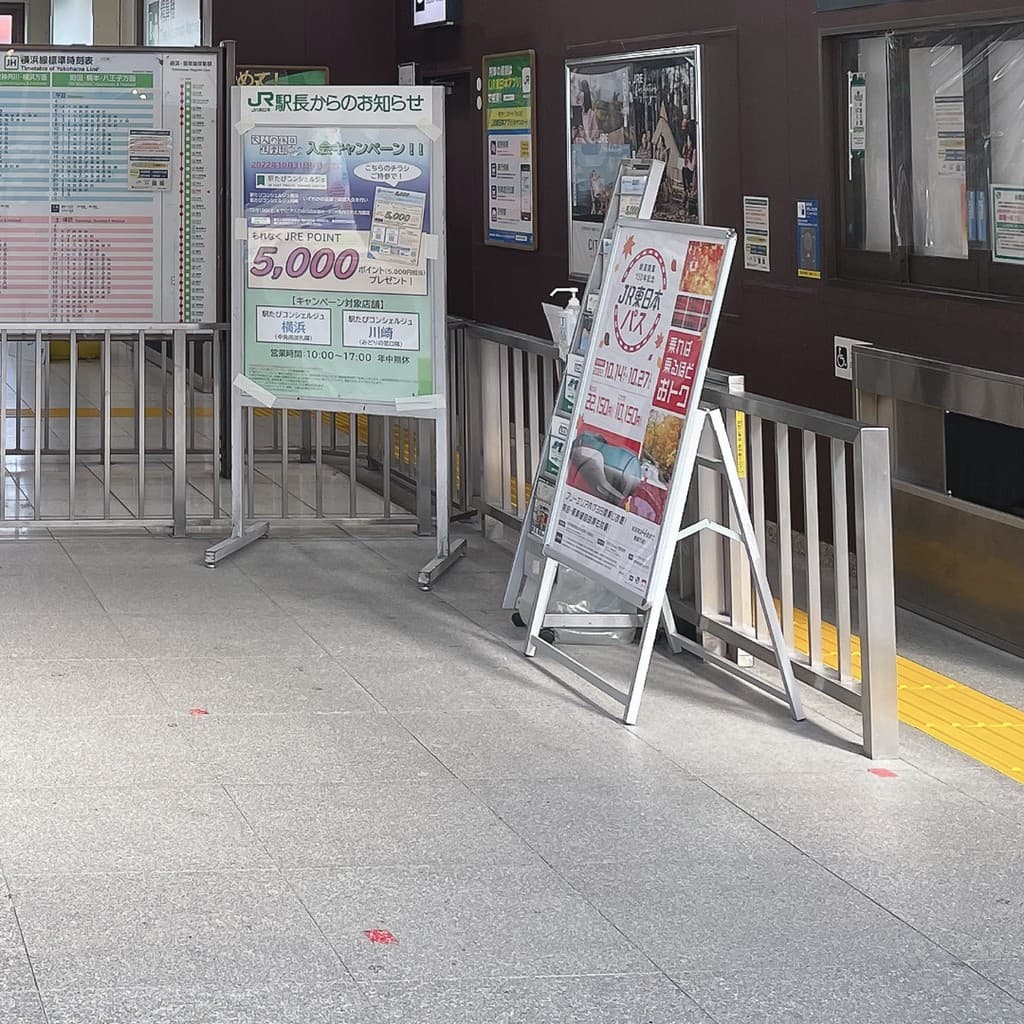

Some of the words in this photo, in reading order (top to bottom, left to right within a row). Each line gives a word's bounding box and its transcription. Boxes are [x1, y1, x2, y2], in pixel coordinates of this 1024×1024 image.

[276, 93, 424, 113] 駅長からのお知らせ
[285, 232, 304, 241] JRE
[307, 232, 342, 243] POINT
[250, 246, 360, 280] 5,000
[618, 285, 663, 311] JR東日本
[281, 321, 306, 334] 横浜
[368, 326, 394, 340] 川崎
